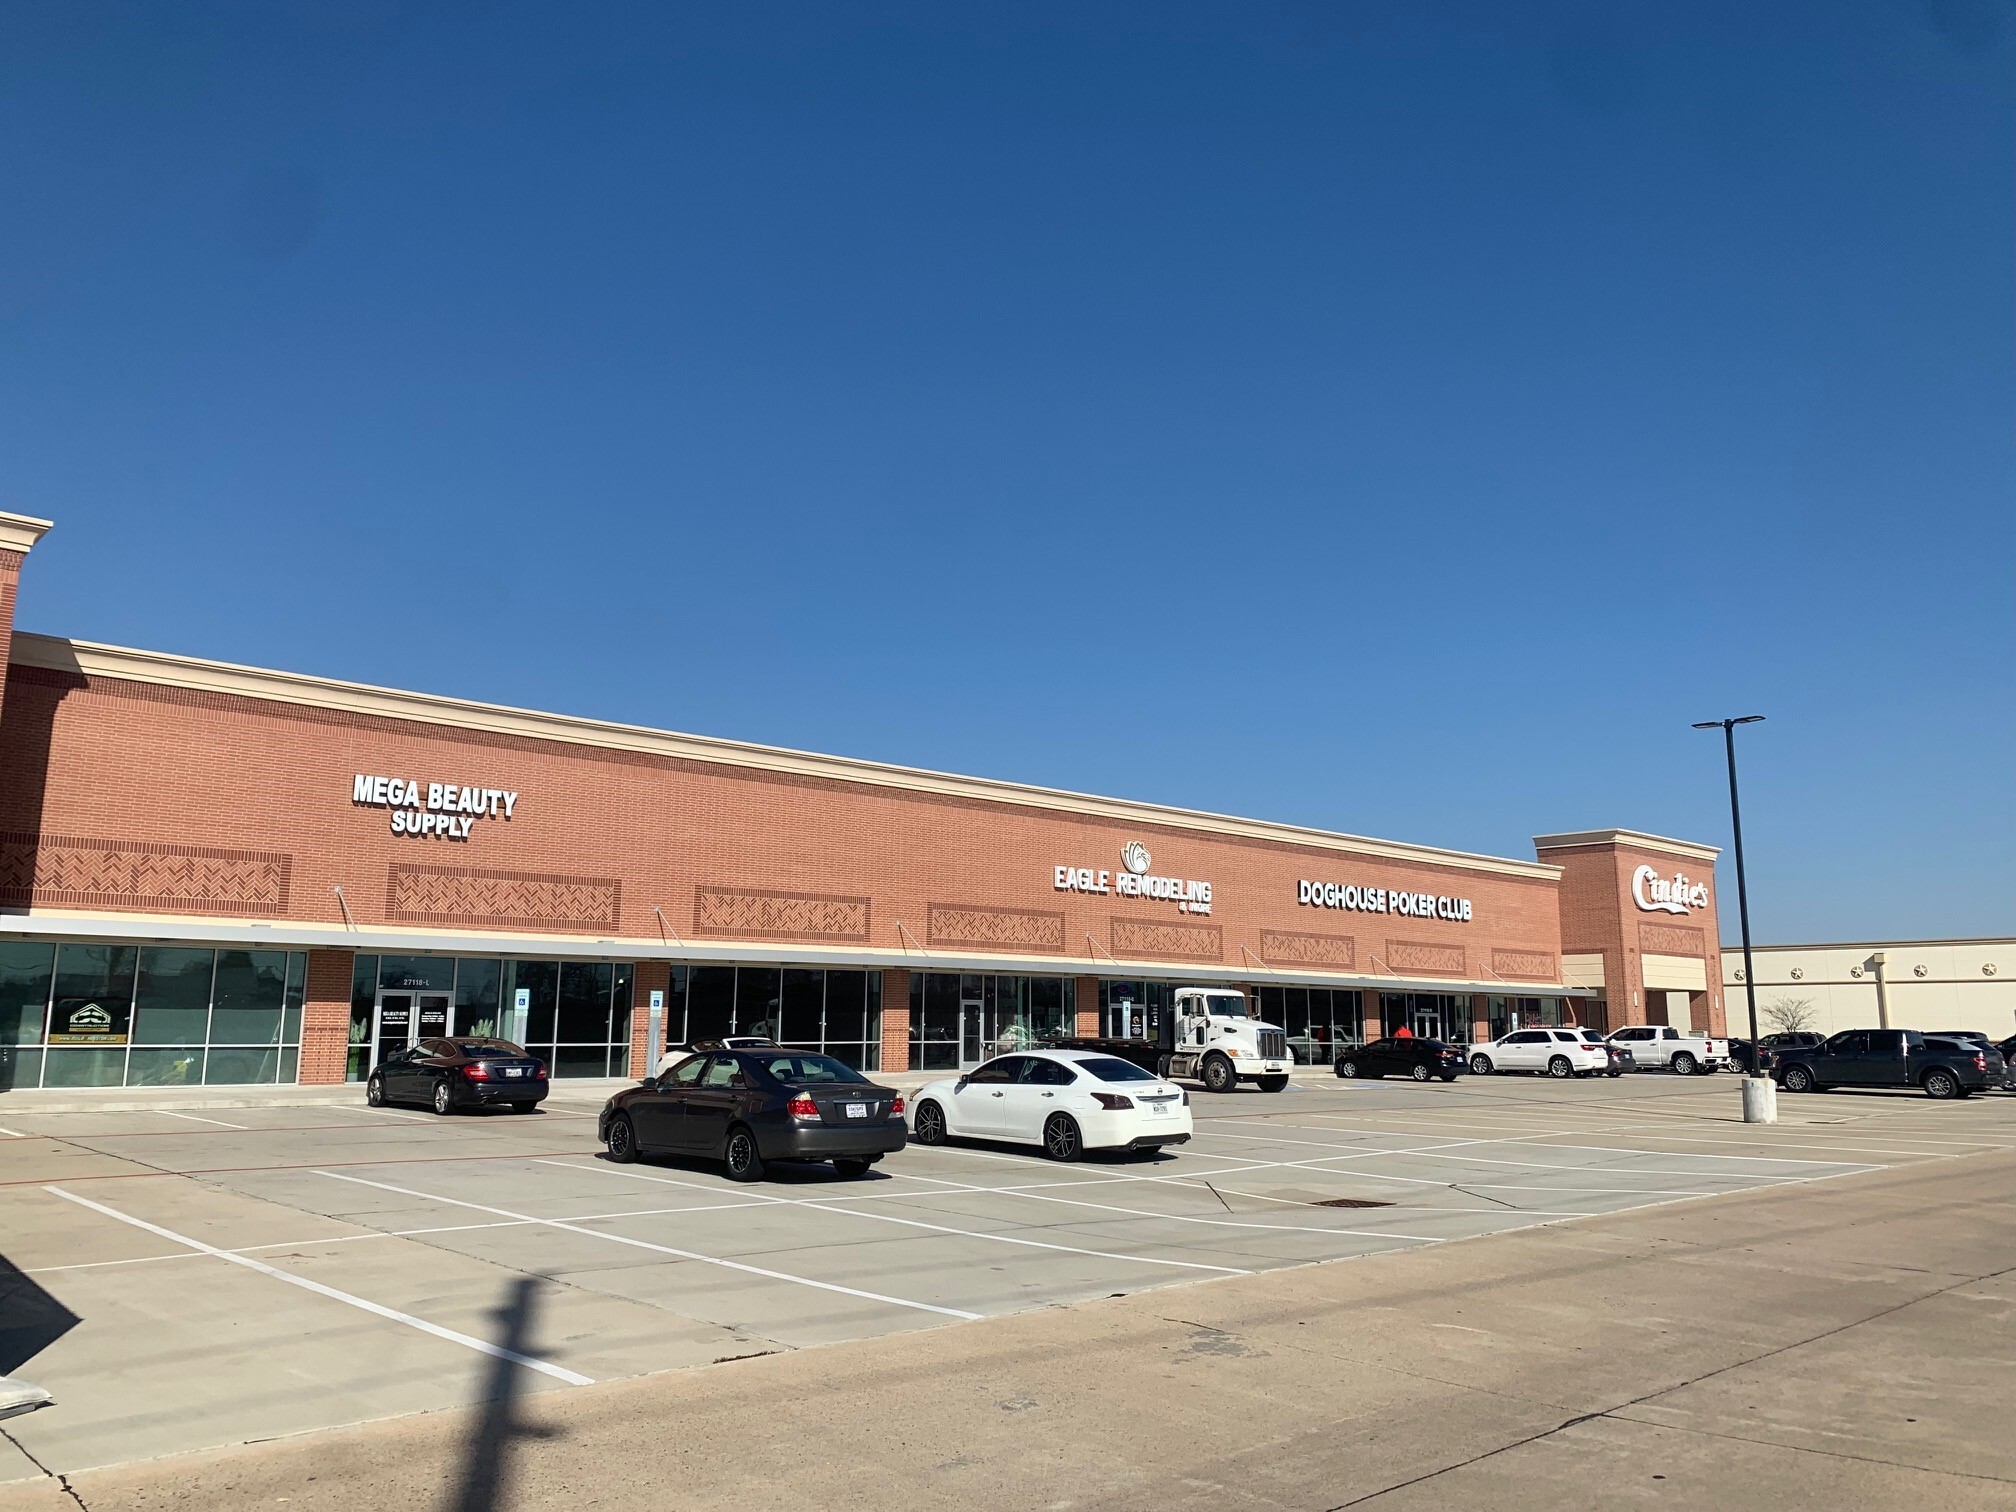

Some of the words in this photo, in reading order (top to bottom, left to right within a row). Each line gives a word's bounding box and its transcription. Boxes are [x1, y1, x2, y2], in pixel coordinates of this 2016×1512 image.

[352, 774, 420, 808] MEGA
[427, 782, 518, 817] BEAUTY
[391, 810, 474, 837] SUPPLY
[1054, 865, 1110, 892] EAGLE
[1115, 872, 1213, 902] REMODELING
[1298, 879, 1386, 912] DOGHOUSE
[1388, 890, 1437, 918] POKER
[1437, 896, 1472, 921] CLUB
[1632, 864, 1709, 914] Cindie's
[1178, 902, 1187, 912] &
[1189, 902, 1213, 914] MORE
